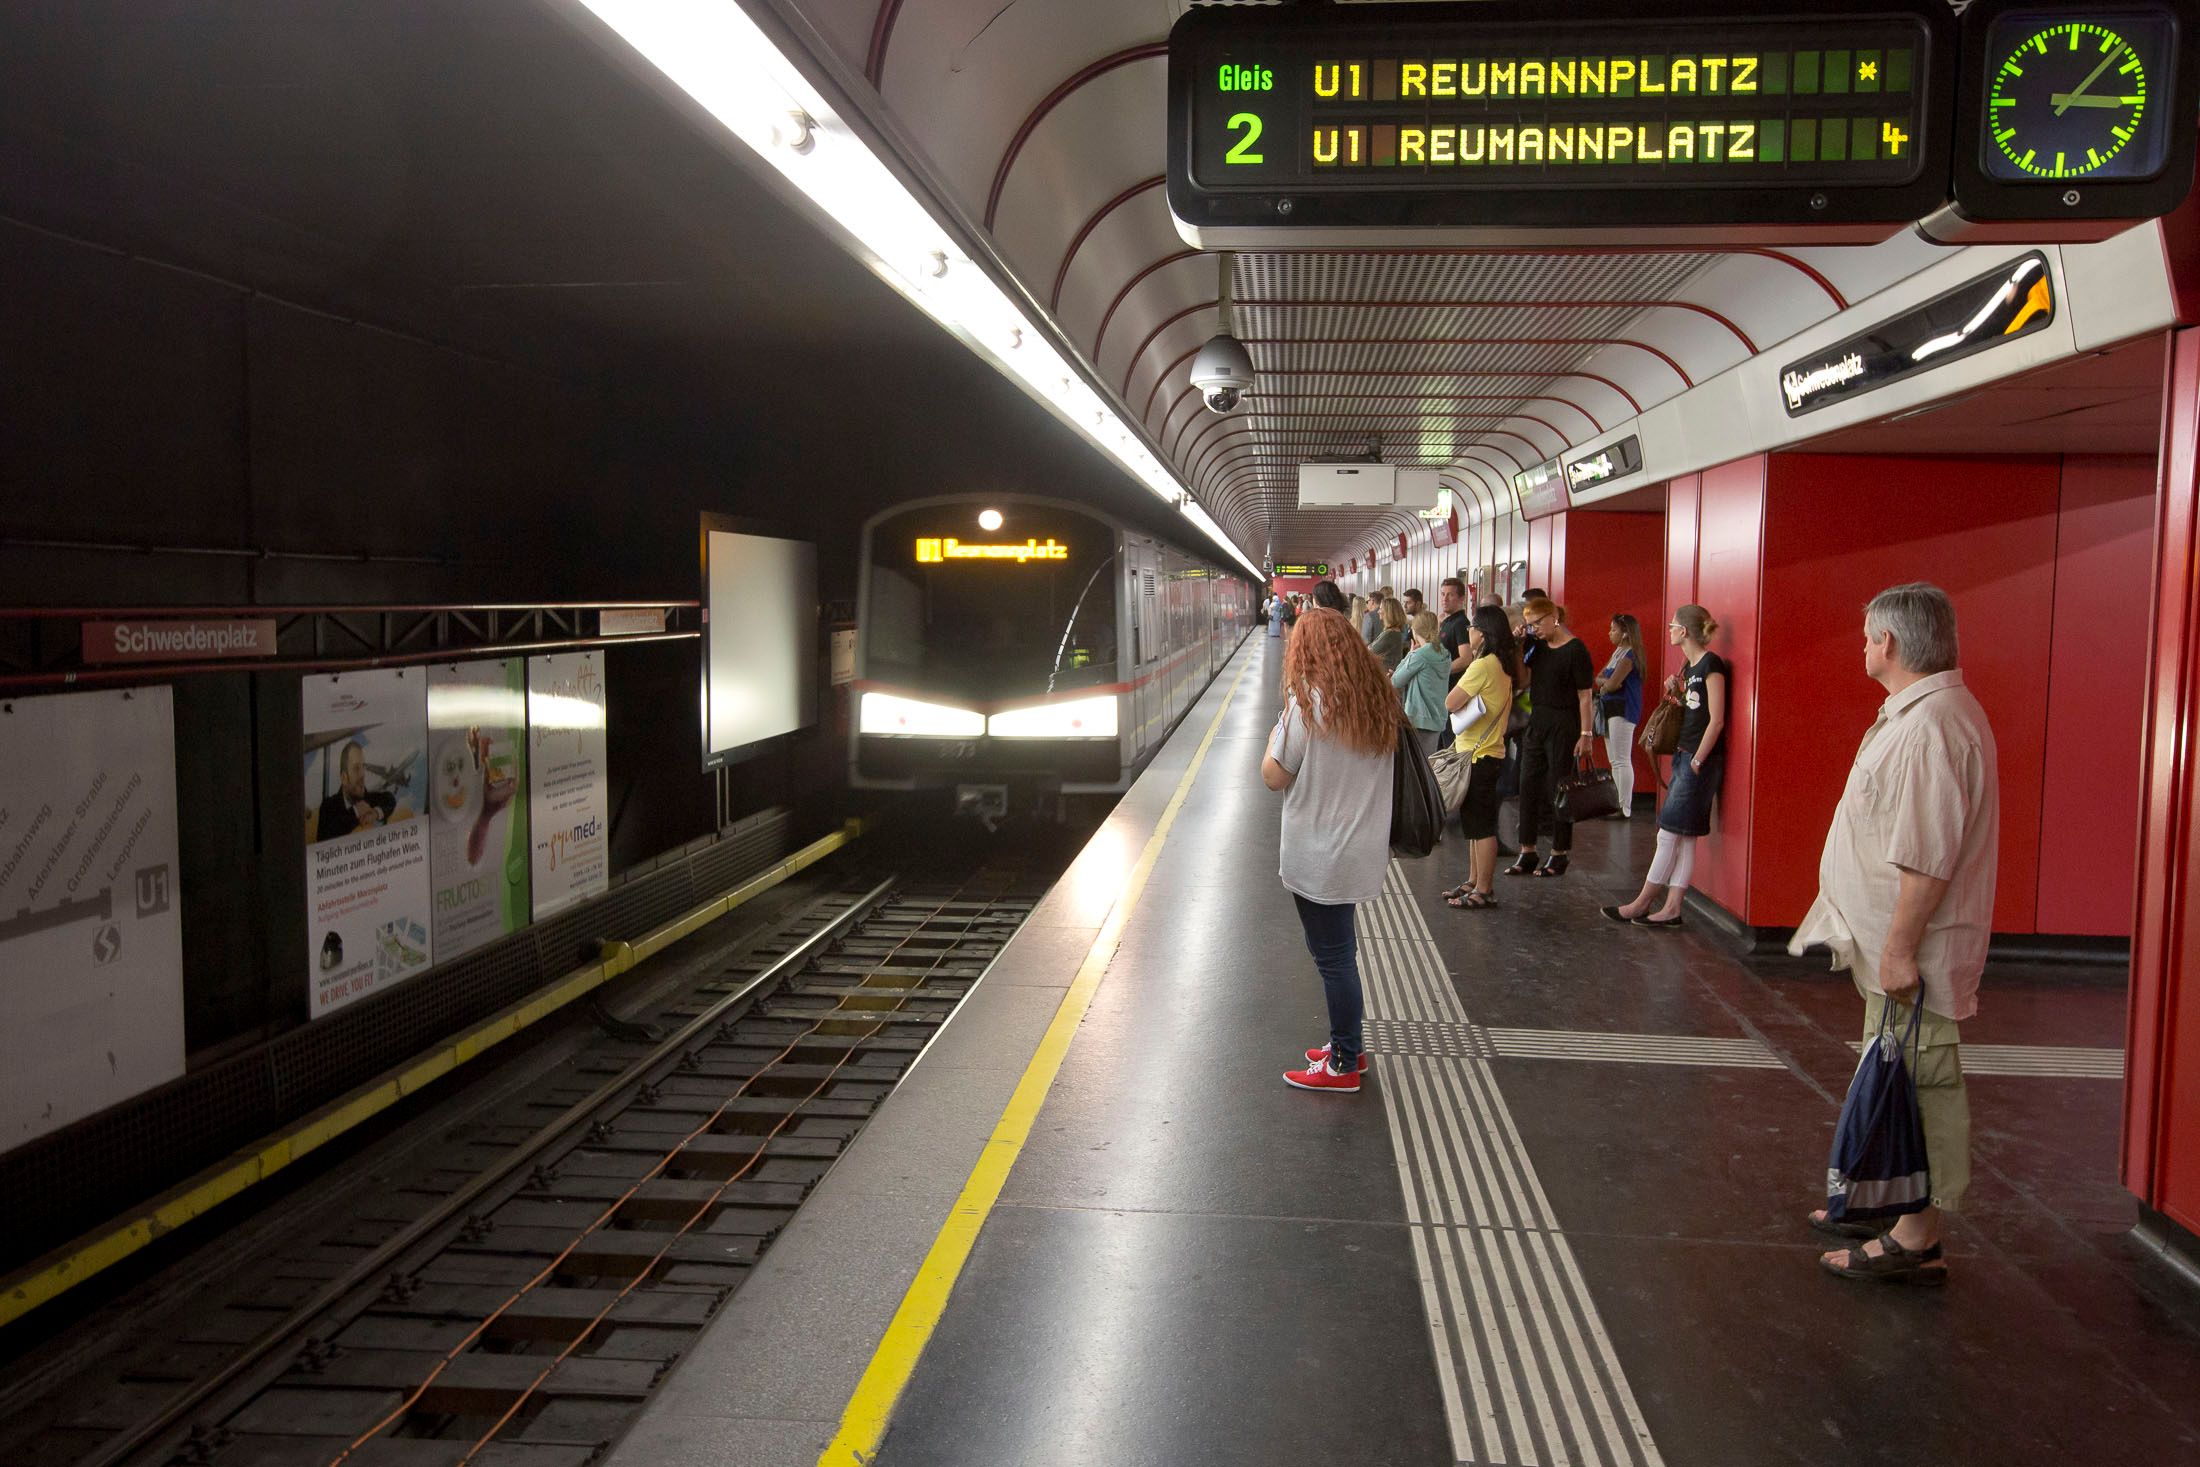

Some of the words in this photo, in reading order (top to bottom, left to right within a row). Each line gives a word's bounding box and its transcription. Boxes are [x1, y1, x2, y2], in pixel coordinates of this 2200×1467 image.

[1218, 64, 1273, 92] Gleis
[1315, 64, 1360, 97] U1
[1402, 58, 1758, 98] REUMANNPLATZ
[1226, 113, 1264, 165] 2
[1314, 129, 1360, 163] U1
[1401, 124, 1755, 163] REUMANNPLATZ
[115, 624, 257, 653] Schwedenplatz
[75, 772, 107, 821] Straße
[67, 772, 142, 893] Großfeldsiedlung
[106, 808, 152, 881] Leopoldau
[316, 846, 343, 863] Täglich
[344, 840, 361, 854] rund
[363, 839, 375, 849] um
[376, 833, 387, 846] die
[388, 831, 401, 843] Uhr
[402, 828, 409, 838] in
[410, 825, 419, 836] 20
[316, 864, 348, 880] Minuten
[349, 858, 366, 870] zum
[367, 847, 401, 866] Flughafen
[137, 870, 168, 910] U1
[351, 975, 363, 993] YOU
[364, 970, 374, 988] FLY
